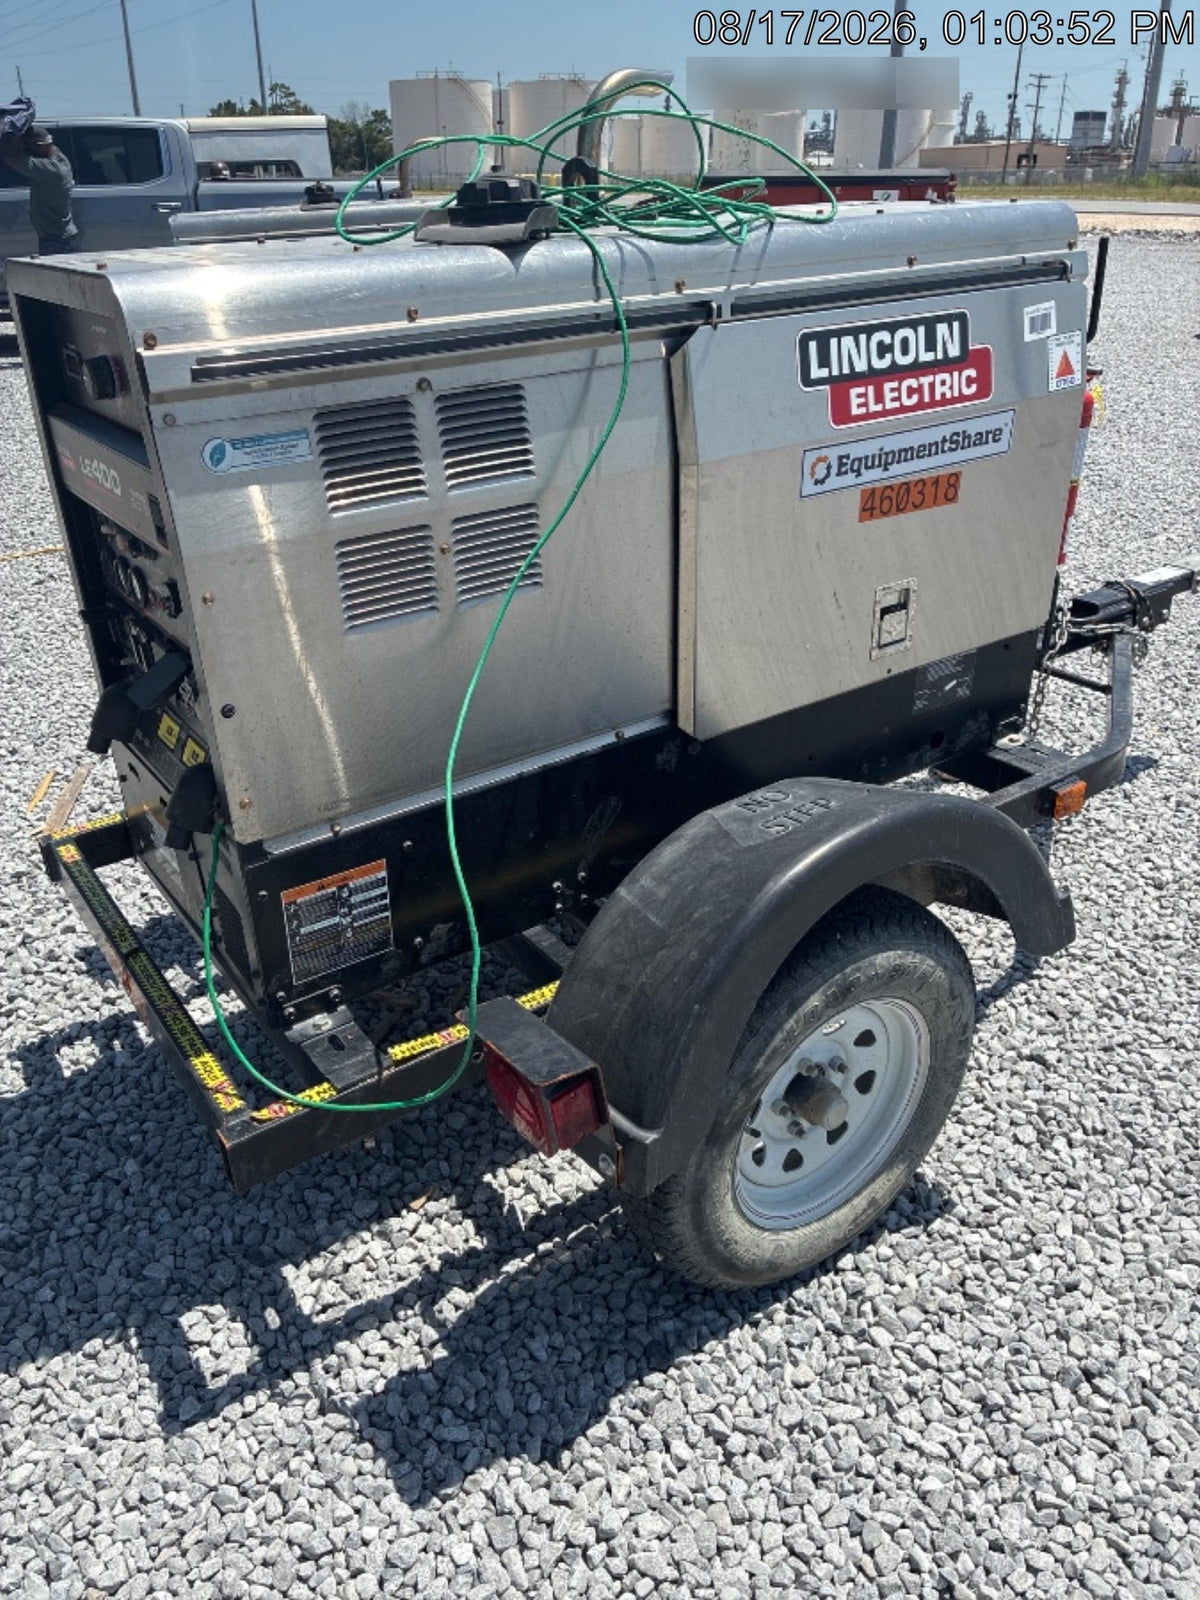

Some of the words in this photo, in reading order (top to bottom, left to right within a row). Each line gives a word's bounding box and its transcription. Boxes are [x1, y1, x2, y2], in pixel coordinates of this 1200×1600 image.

[808, 320, 961, 379] LINCOLN
[850, 368, 977, 416] ELECTRIC
[835, 426, 1003, 478] EquipmentShare
[860, 472, 961, 518] 460318
[736, 790, 791, 813] NO
[760, 797, 833, 835] STEP
